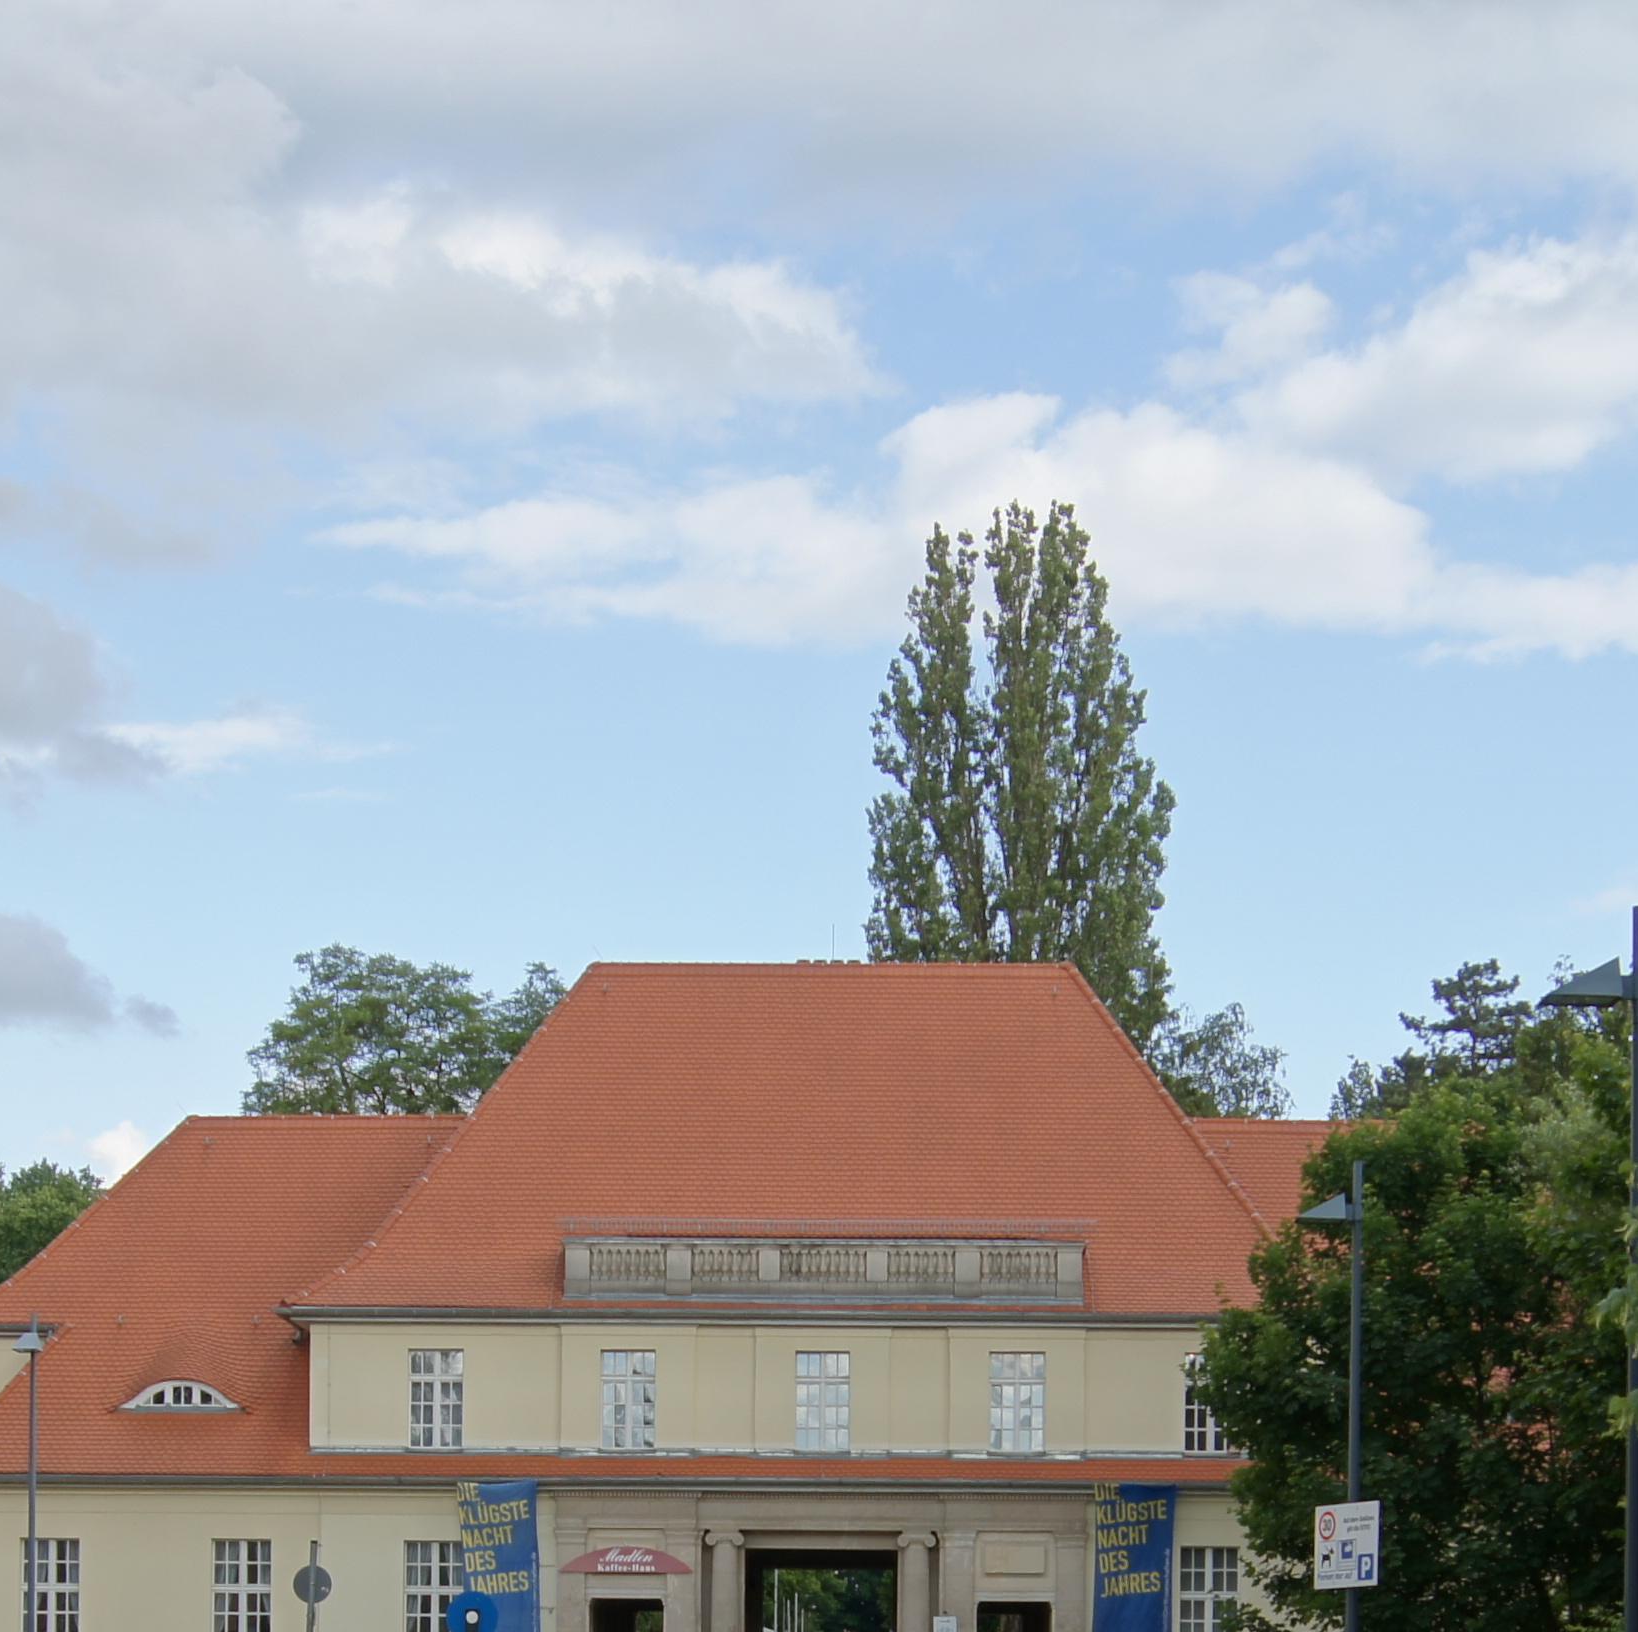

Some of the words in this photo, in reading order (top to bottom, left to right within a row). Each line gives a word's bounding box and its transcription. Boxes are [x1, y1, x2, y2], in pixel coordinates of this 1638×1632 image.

[457, 1482, 480, 1501] DIE
[1095, 1482, 1121, 1501] DIE
[458, 1500, 530, 1525] KLÜGSTE
[1097, 1499, 1167, 1525] KLÜGSTE
[462, 1525, 513, 1549] NACHT
[1098, 1524, 1148, 1550] NACHT
[464, 1551, 497, 1573] DES
[1099, 1550, 1129, 1574] DES
[1101, 1571, 1161, 1598] JAHRES
